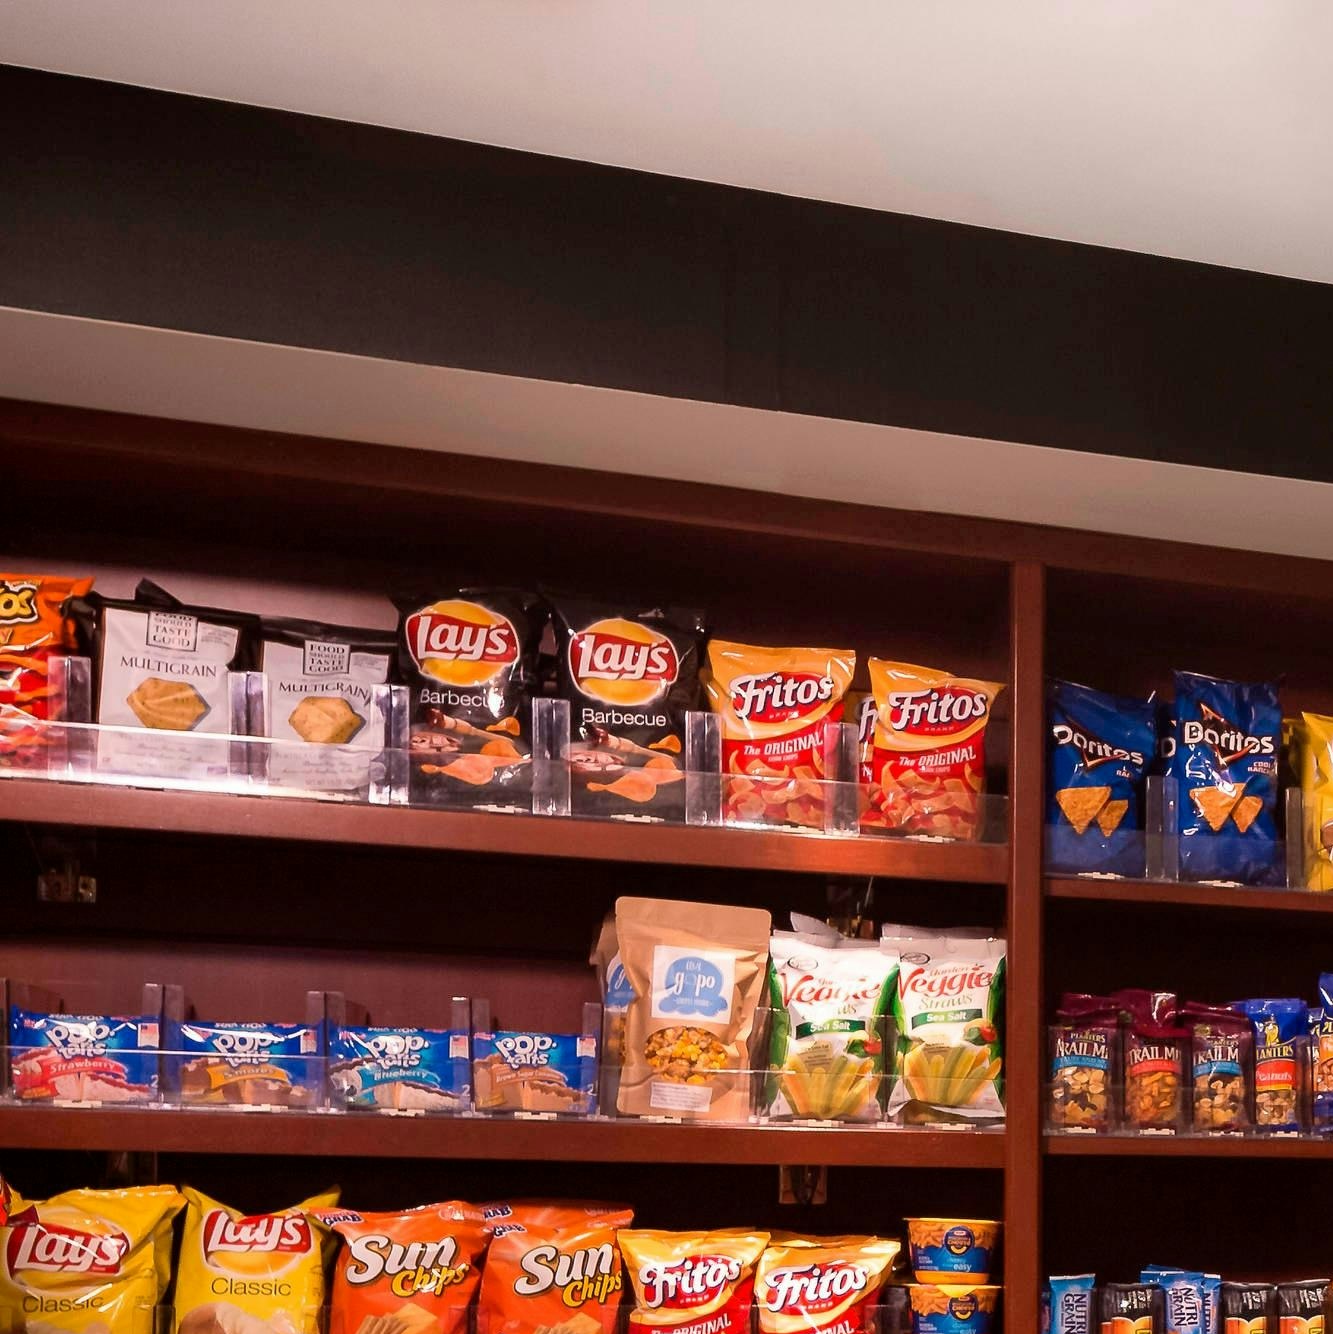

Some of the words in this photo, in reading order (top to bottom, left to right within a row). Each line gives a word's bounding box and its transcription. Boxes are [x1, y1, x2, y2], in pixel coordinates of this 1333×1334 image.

[417, 615, 509, 661] Lay's
[120, 655, 217, 678] MULTIGRAIN
[578, 634, 670, 681] Lay's
[279, 681, 373, 706] MULTIGRAIN
[729, 672, 834, 718] Fritos
[888, 689, 987, 731] Fritos
[582, 707, 667, 727] Barbecue
[764, 730, 824, 755] ORIGINAL
[1053, 724, 1144, 766] Doritos
[1184, 721, 1275, 755] Doritos
[900, 755, 916, 766] The
[918, 746, 977, 767] ORIGINAL
[898, 967, 993, 1000] Veggie
[832, 1021, 851, 1031] Salt
[926, 1013, 947, 1023] Sea
[949, 1011, 967, 1021] Salt
[50, 1059, 116, 1074] Strawberry
[346, 1235, 457, 1285] Sun
[514, 1244, 614, 1296] Sun
[953, 1262, 972, 1273] easy
[211, 1277, 292, 1297] Classic
[391, 1262, 470, 1297] Chips
[562, 1269, 622, 1308] Chips
[639, 1255, 744, 1310] Fritos
[764, 1260, 870, 1313] Fritos
[22, 1295, 104, 1314] Classic
[1074, 1293, 1087, 1334] NUTRI
[1182, 1286, 1199, 1326] NUTRI
